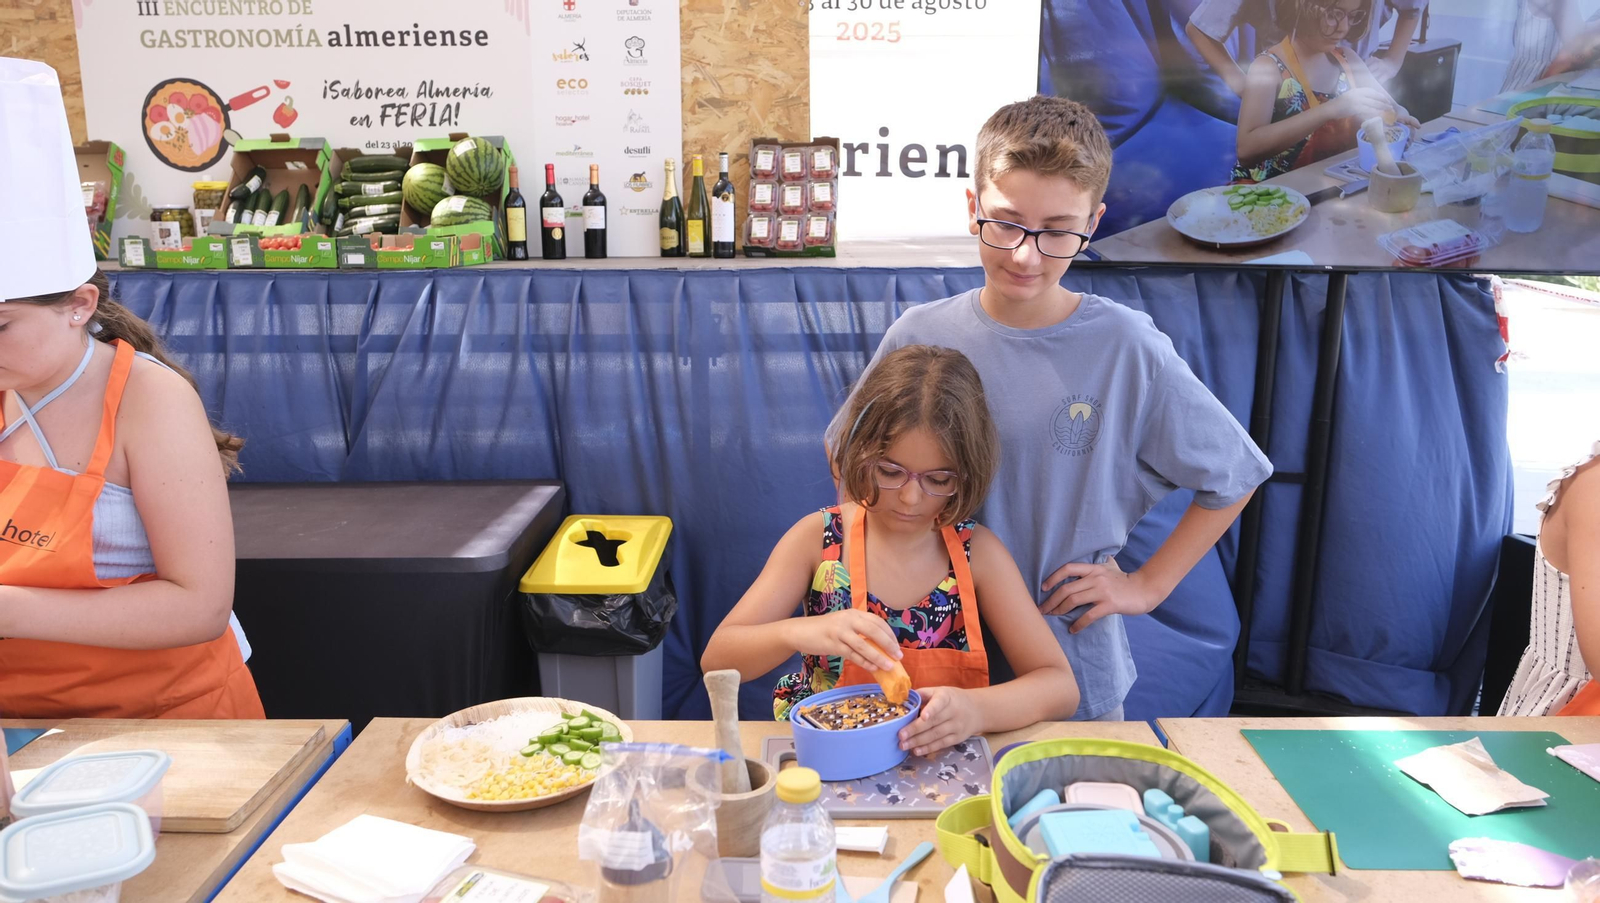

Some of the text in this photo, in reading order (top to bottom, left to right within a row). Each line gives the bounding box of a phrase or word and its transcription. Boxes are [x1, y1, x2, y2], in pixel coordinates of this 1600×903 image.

[137, 0, 313, 16] III ENCUENTRO DE
[911, 0, 987, 15] agosto
[140, 23, 489, 48] GASTRONOMÍA almeriense
[836, 20, 902, 43] 2025
[416, 79, 494, 99] Almería
[556, 79, 588, 89] eco
[350, 102, 461, 128] en FERIA!
[365, 140, 379, 149] del
[842, 126, 970, 178] rien
[1061, 394, 1102, 408] SURF SHOP
[1051, 441, 1094, 457] CALIFORNIA
[1, 518, 57, 547] hotel
